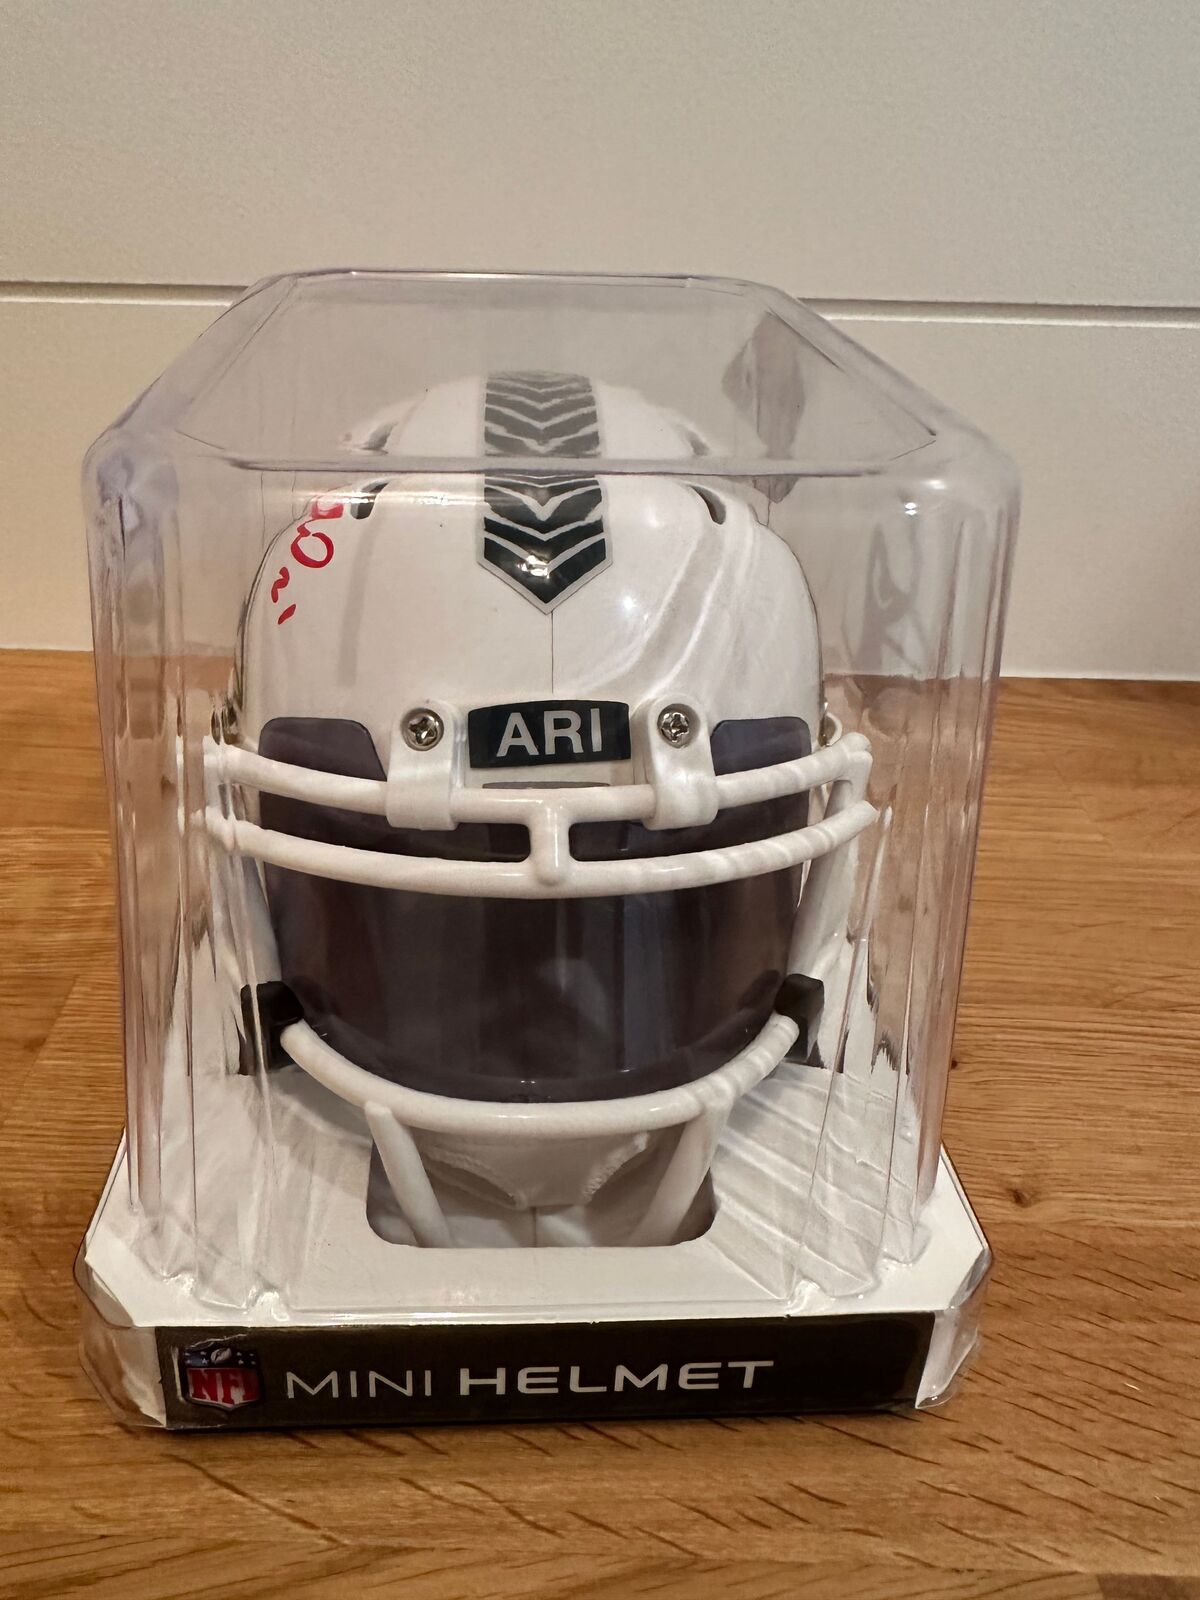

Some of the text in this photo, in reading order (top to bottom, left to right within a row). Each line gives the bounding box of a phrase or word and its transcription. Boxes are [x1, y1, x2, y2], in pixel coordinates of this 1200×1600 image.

[496, 708, 603, 757] ARI
[286, 1360, 774, 1399] MINI HELMET
